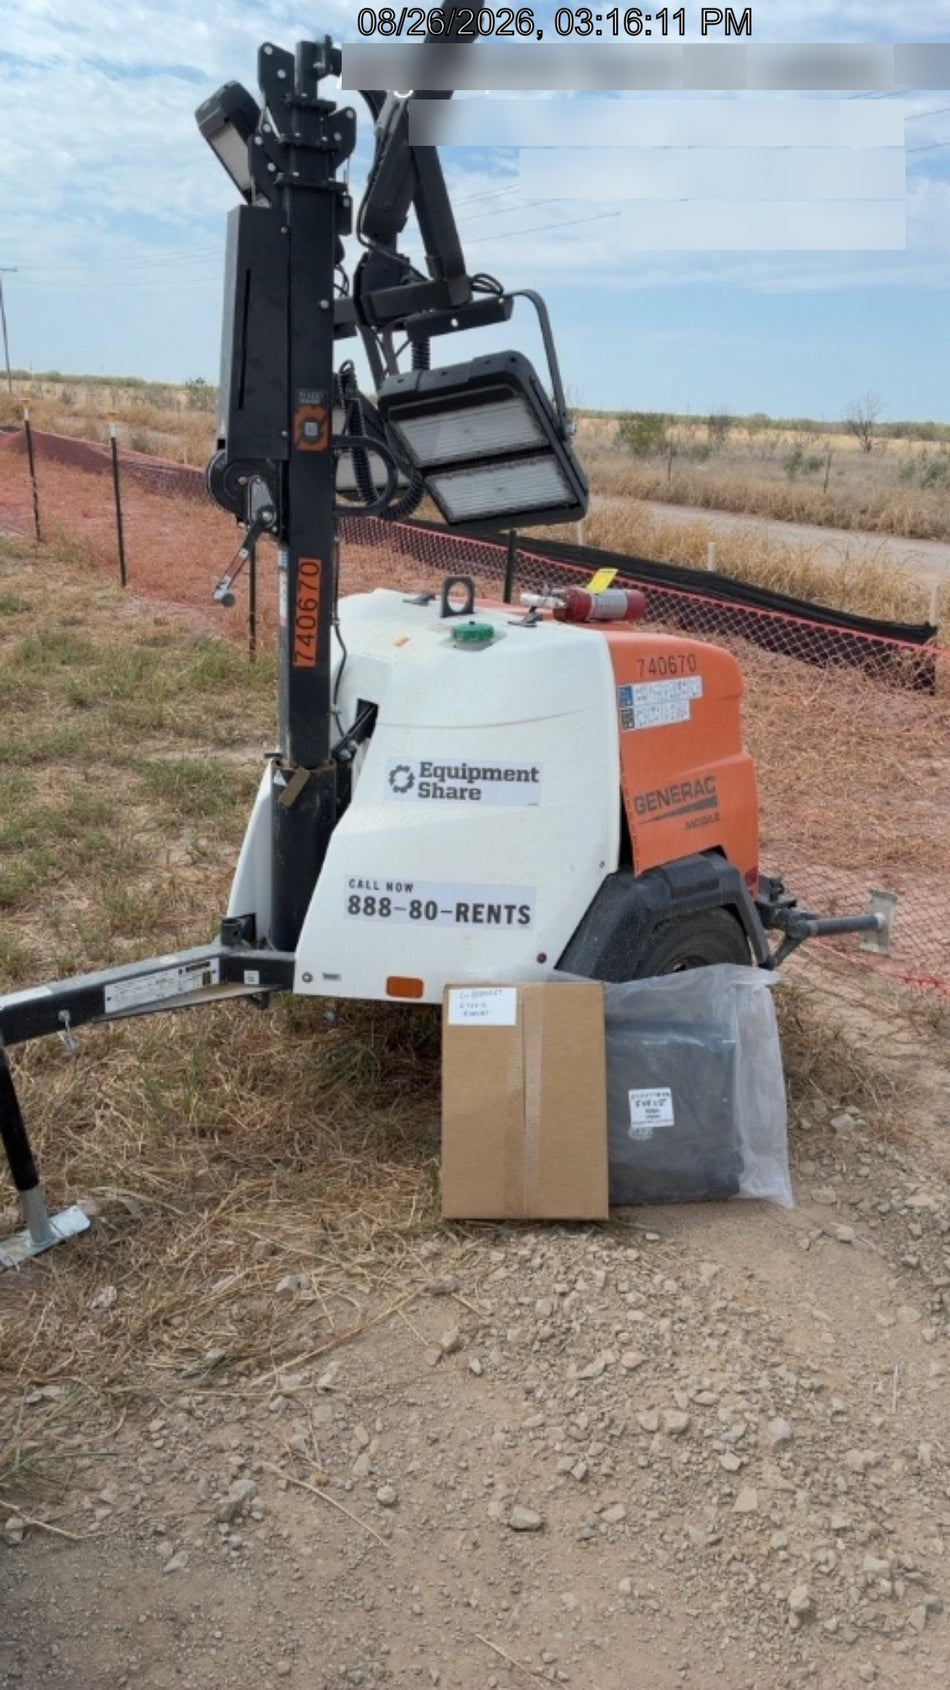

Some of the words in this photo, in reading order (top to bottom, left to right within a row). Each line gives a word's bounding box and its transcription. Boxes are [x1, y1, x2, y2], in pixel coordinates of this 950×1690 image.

[294, 559, 320, 664] 740670
[637, 653, 698, 677] 740670
[419, 761, 540, 783] Equipment
[417, 781, 482, 801] Share
[633, 776, 718, 816] GENERAC
[348, 878, 380, 891] CALL
[386, 881, 414, 893] NOW
[346, 894, 531, 925] 888-80-RENTS
